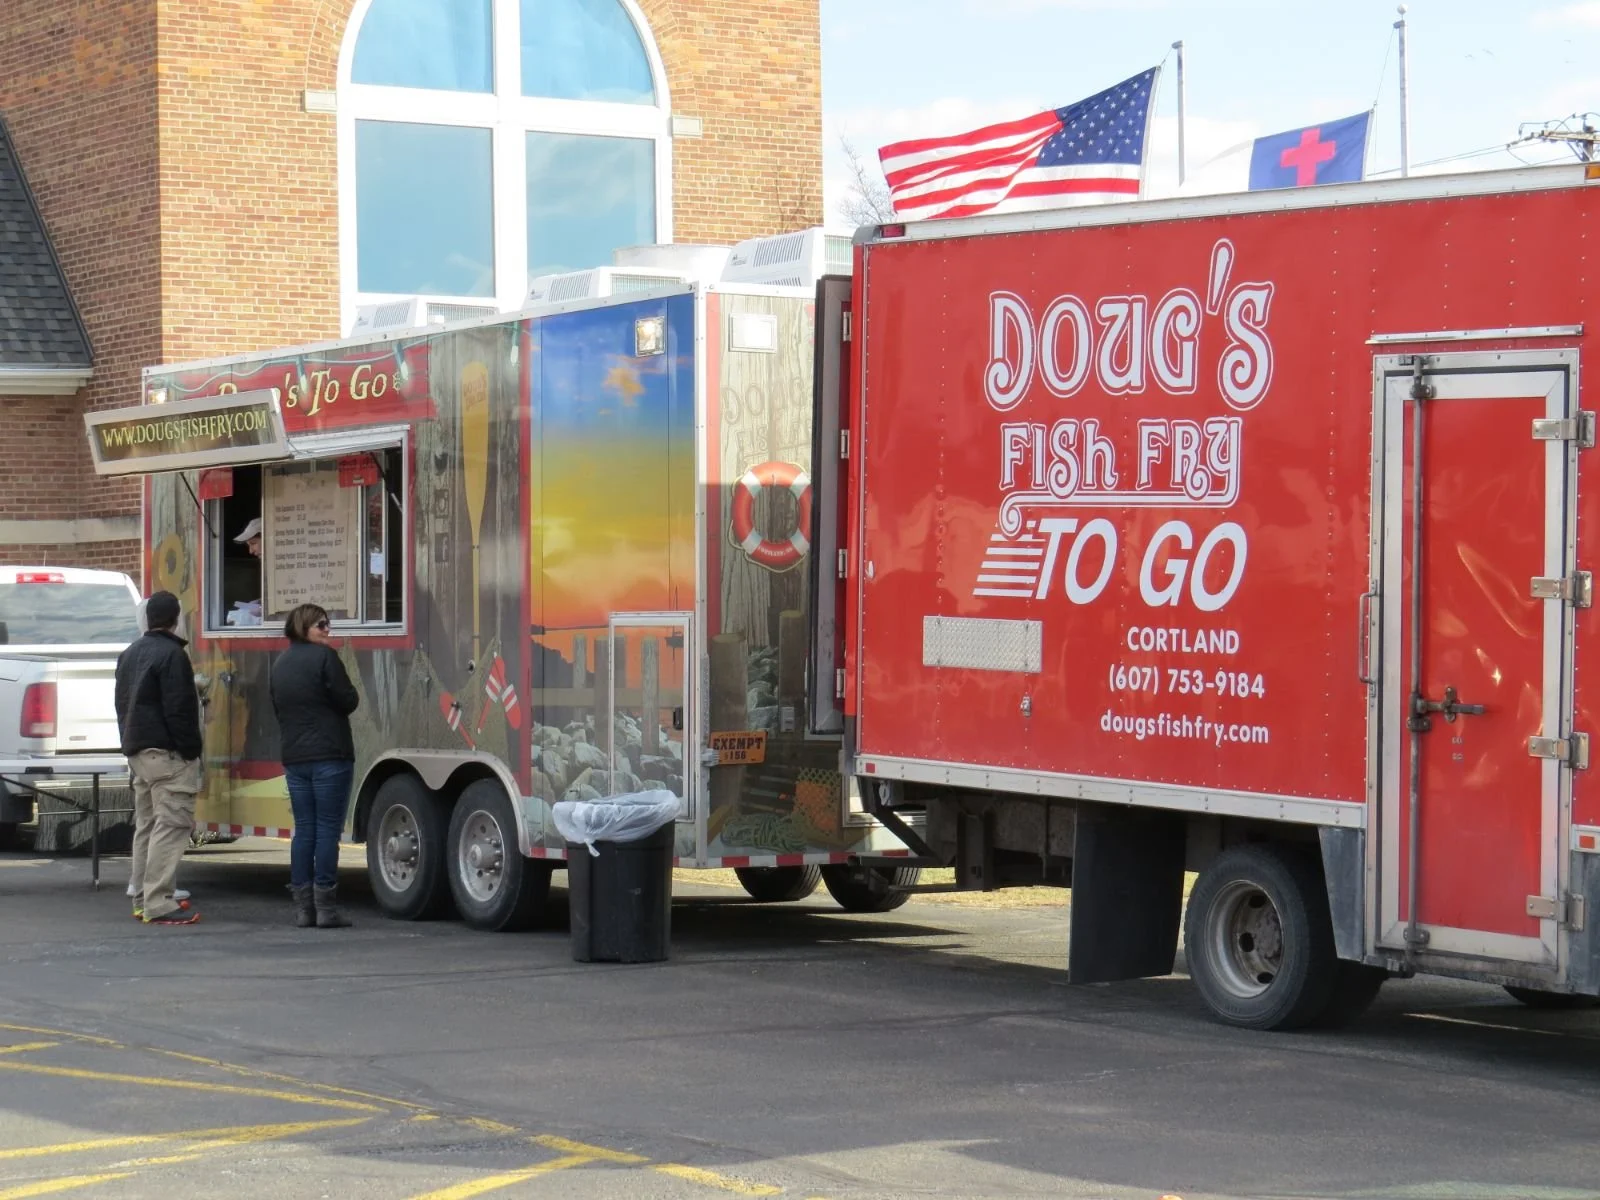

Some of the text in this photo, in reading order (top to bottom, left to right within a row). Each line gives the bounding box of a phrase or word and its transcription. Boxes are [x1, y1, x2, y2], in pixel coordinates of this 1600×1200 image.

[983, 238, 1276, 412] DOUG'S
[307, 367, 341, 417] To
[350, 363, 388, 402] Go
[102, 410, 268, 448] WWW.DOUGSFISHFRY.COM
[1036, 518, 1248, 612] TO GO
[1126, 626, 1240, 655] CORTLAND
[1109, 664, 1265, 699] (607) 753-9184
[712, 737, 763, 750] EXEMPT
[1100, 708, 1269, 747] dougsfishfry.com
